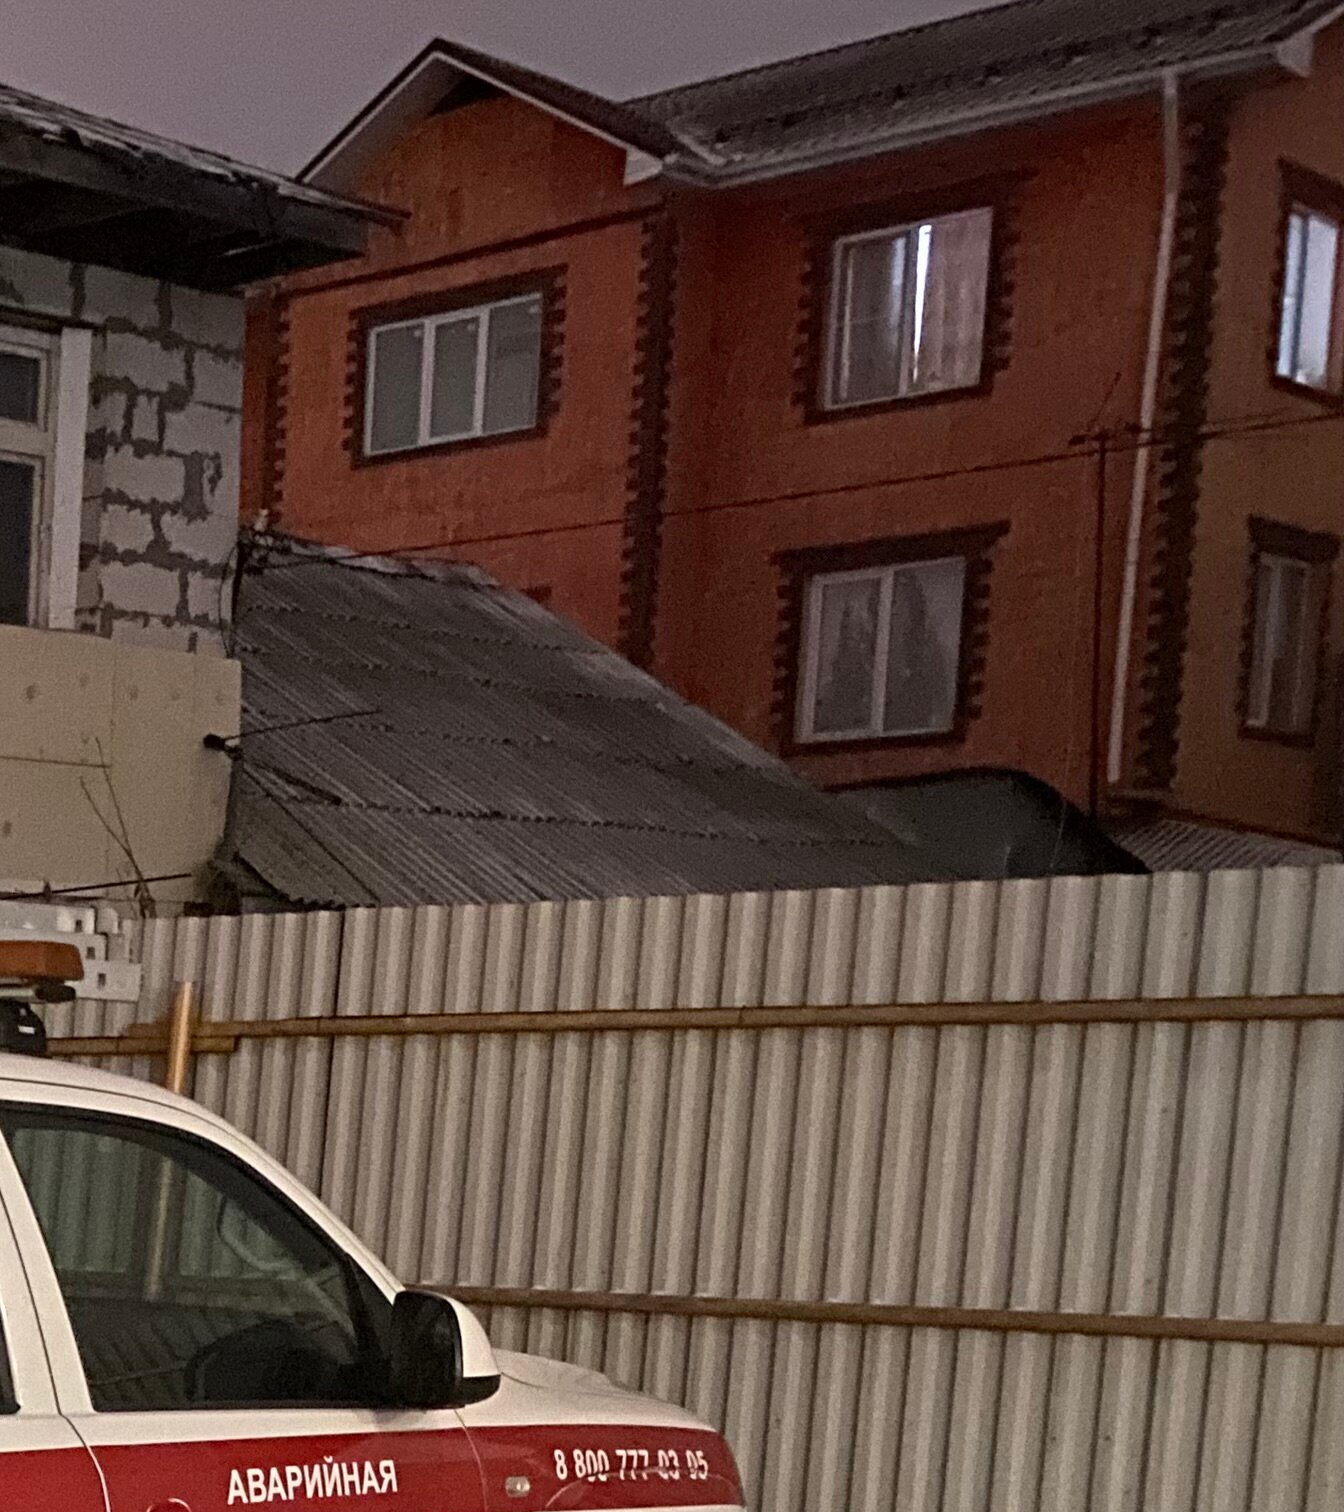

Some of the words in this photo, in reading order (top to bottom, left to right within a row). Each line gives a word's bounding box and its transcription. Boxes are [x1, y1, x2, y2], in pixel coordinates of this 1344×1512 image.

[227, 1455, 398, 1505] АВАРИЙНАЯ
[553, 1449, 568, 1480] 8
[572, 1448, 610, 1482] 800
[615, 1449, 649, 1480] 777
[657, 1449, 680, 1480] 03
[685, 1450, 709, 1480] 05
